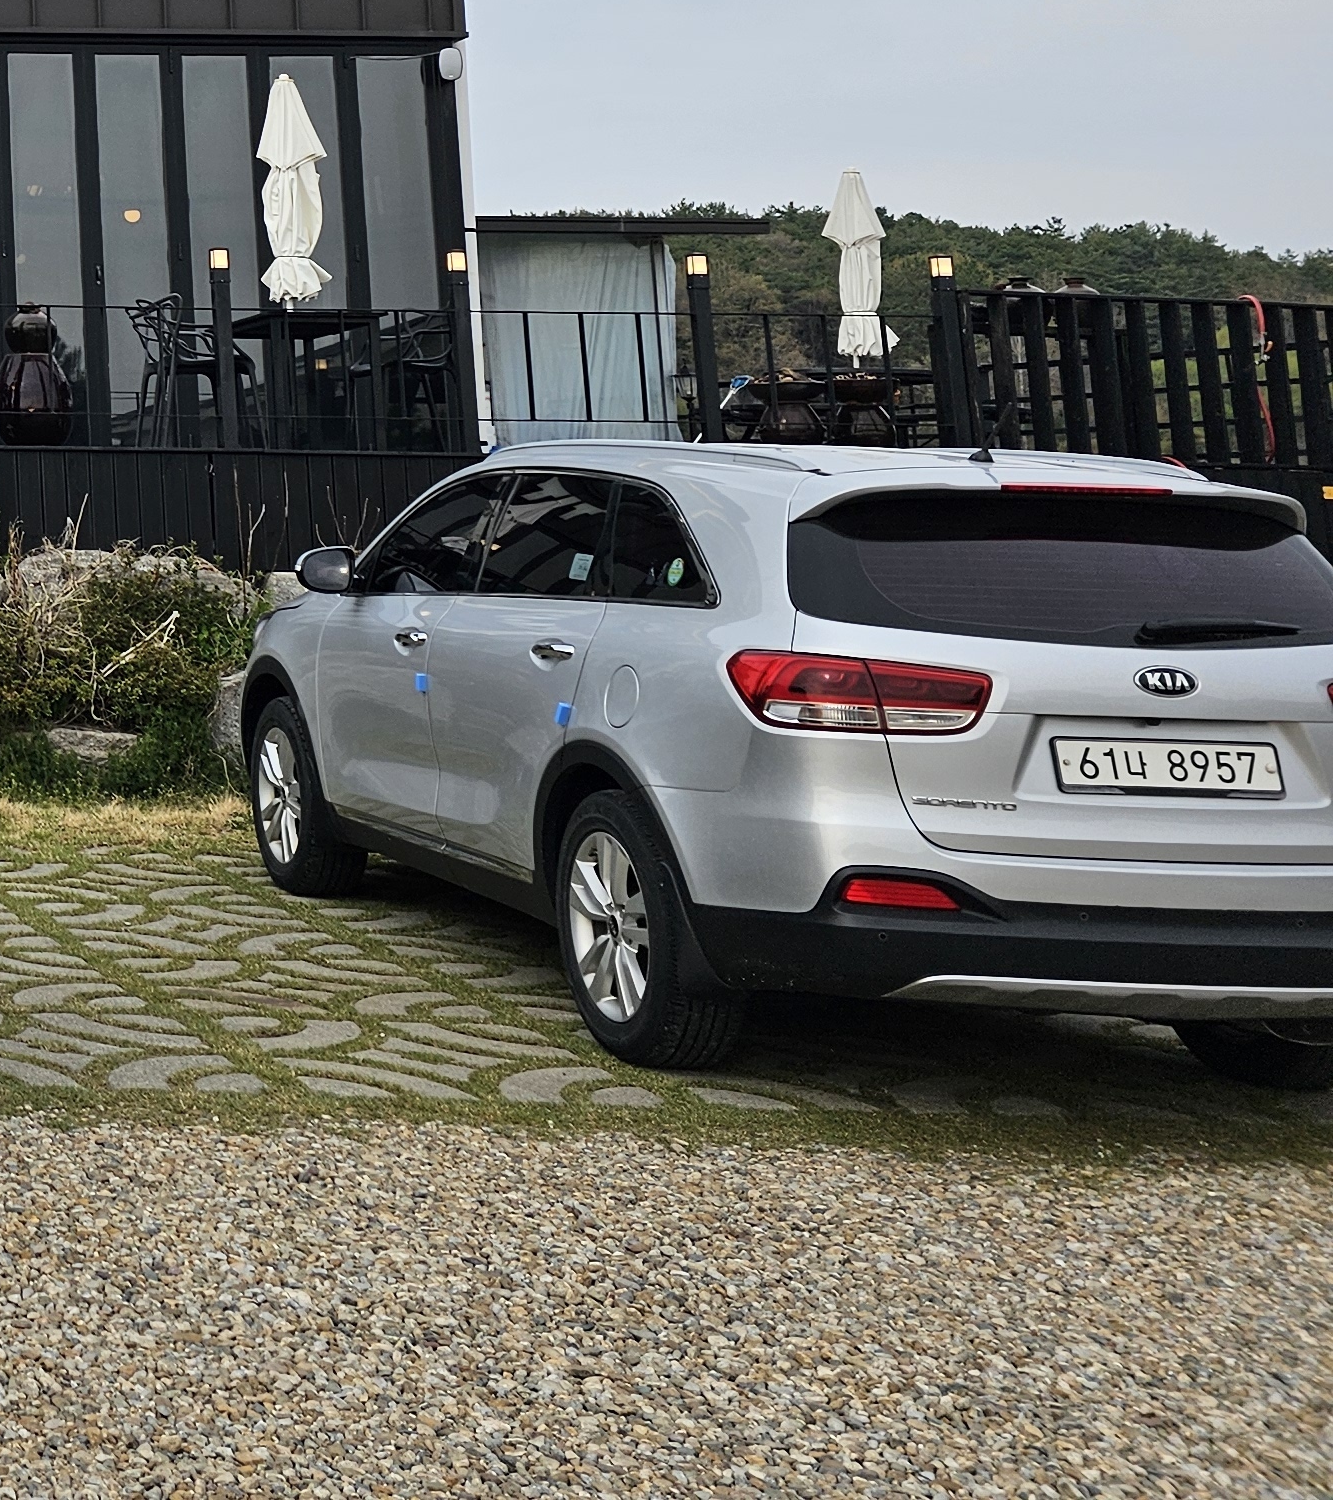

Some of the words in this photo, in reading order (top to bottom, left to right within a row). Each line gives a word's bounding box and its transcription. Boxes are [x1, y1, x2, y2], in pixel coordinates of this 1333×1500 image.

[1144, 671, 1192, 691] KIA
[1079, 747, 1148, 780] 61나
[1166, 749, 1256, 784] 8957
